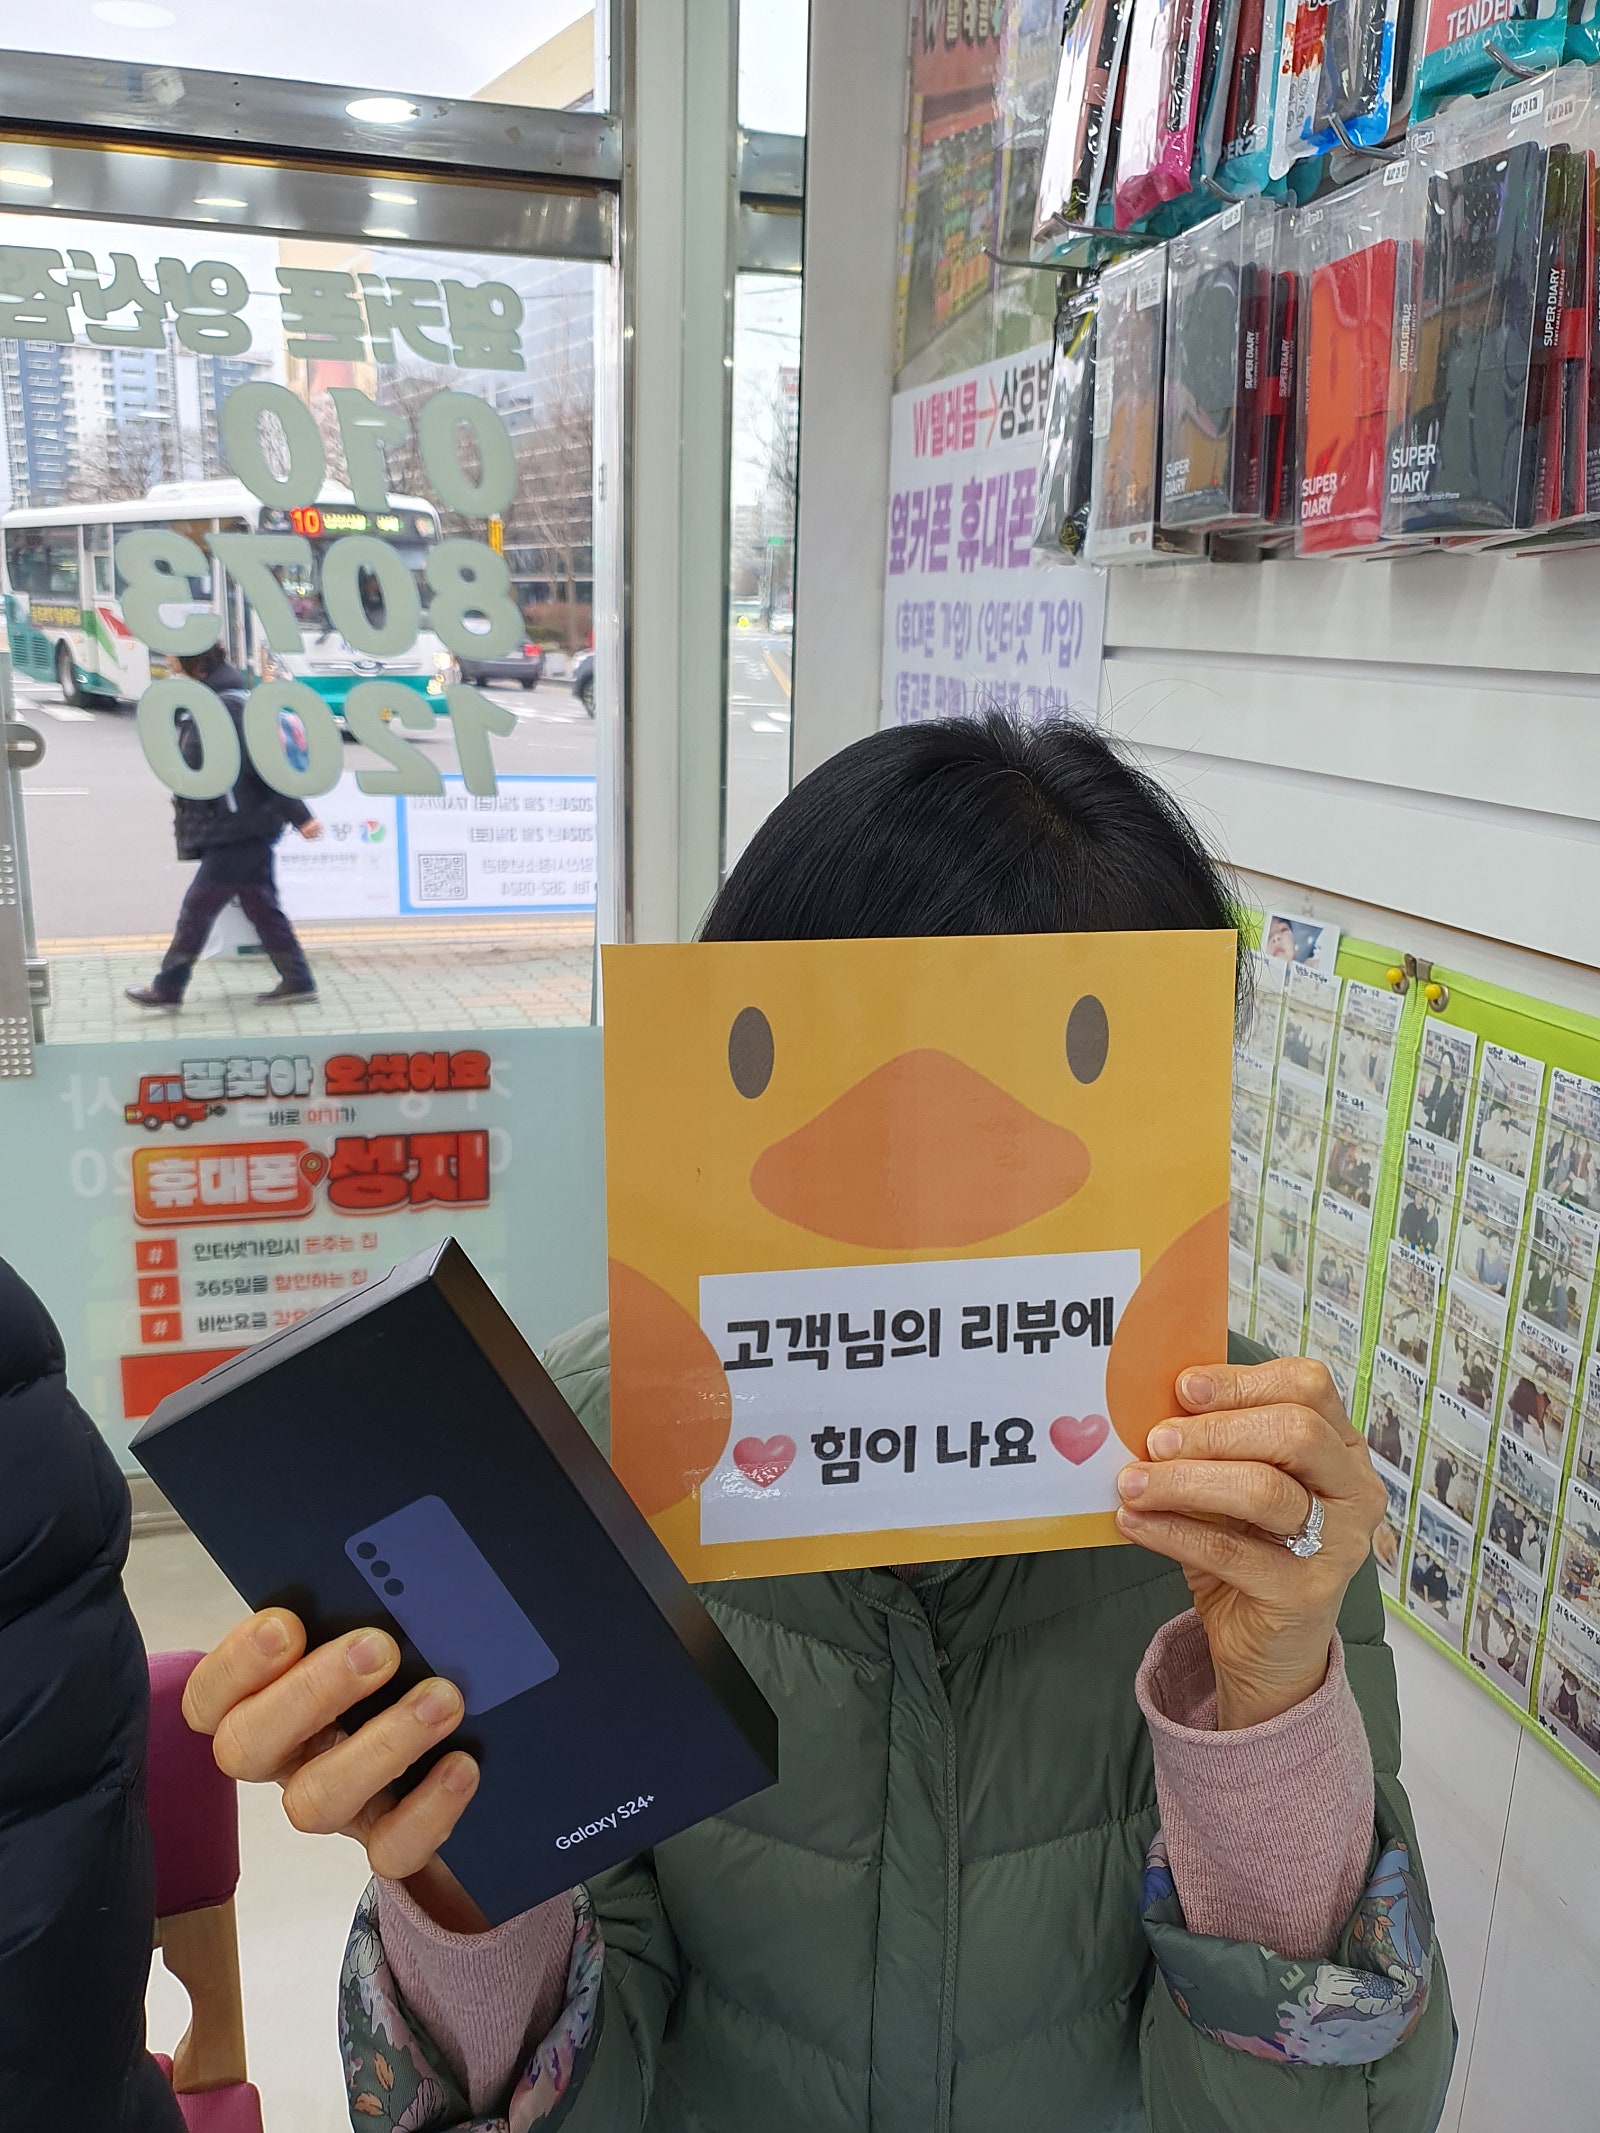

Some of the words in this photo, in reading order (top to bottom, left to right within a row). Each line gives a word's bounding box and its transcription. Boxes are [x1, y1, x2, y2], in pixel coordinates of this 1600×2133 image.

[1447, 0, 1526, 42] TENDER
[1443, 31, 1480, 64] DIARY
[1482, 20, 1525, 46] CASE
[1548, 268, 1560, 305] DIARY
[1544, 306, 1556, 347] SUPER
[1246, 330, 1255, 358] DIARY
[1165, 458, 1190, 478] SUPER
[1391, 444, 1436, 469] SUPER
[1164, 477, 1188, 497] DIARY
[1301, 472, 1338, 497] SUPER
[1390, 470, 1430, 494] DIARY
[290, 507, 321, 536] 10
[957, 468, 1037, 574] 휴대폰
[1301, 496, 1335, 518] DIARY
[978, 600, 1034, 664] (인터넷
[1039, 600, 1084, 668] 가입)
[181, 1056, 314, 1100] 잘찾아
[325, 1050, 491, 1096] 오셨어요
[268, 1110, 300, 1127] 바로
[306, 1107, 356, 1125] 여기가
[149, 1153, 299, 1208] 휴대폰
[328, 1130, 491, 1209] 성지
[193, 1238, 300, 1262] 인터넷가입시
[199, 1311, 268, 1333] 비싼요금
[723, 1307, 942, 1371] 고객님의
[961, 1297, 1114, 1354] 리뷰에
[810, 1425, 917, 1485] 힘이
[936, 1417, 1037, 1470] 나요
[555, 1812, 618, 1850] Galaxy
[616, 1795, 655, 1819] S24+
